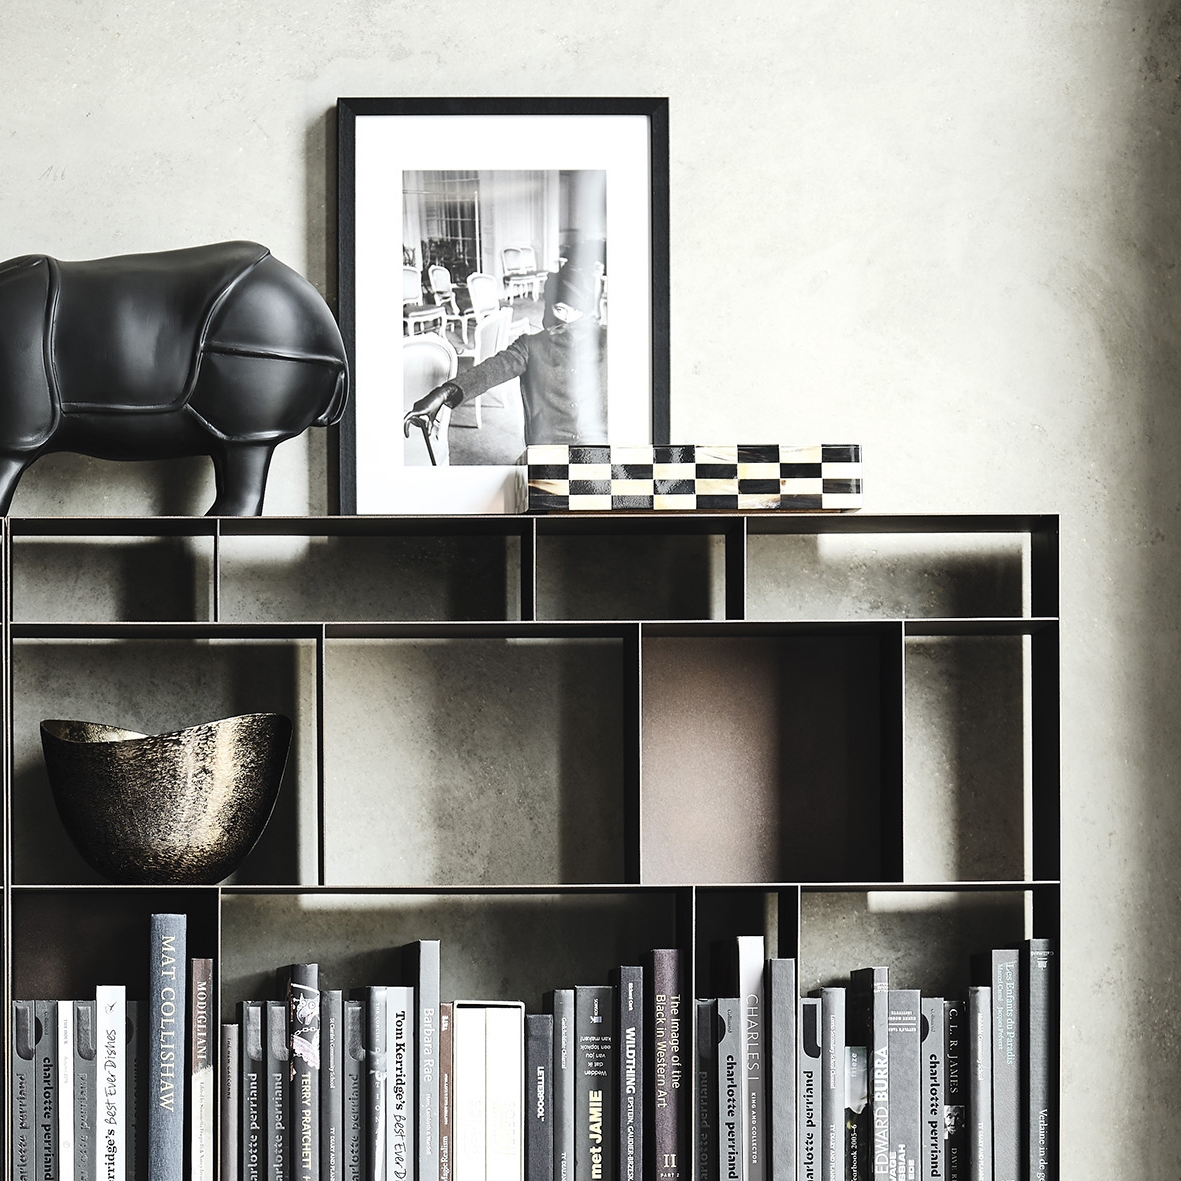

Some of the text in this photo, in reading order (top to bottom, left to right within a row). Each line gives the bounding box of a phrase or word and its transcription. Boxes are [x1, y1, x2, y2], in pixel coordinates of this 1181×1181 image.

[159, 935, 176, 1112] MAT COLLISHAW
[197, 981, 208, 1060] MODIGLIANI
[396, 1010, 406, 1040] Tom
[669, 994, 682, 1089] The Image of the
[746, 994, 760, 1071] CHARLES
[1006, 963, 1016, 1065] Les Enfants du Paradis
[104, 1029, 117, 1071] Dishes
[423, 1008, 435, 1082] Barbara Rae
[655, 994, 668, 1108] Black in Western Art
[947, 1008, 959, 1094] C. L. R. JAMES
[247, 1073, 260, 1130] perriand
[273, 1073, 285, 1130] perriand
[301, 1072, 312, 1106] TERRY
[348, 1074, 361, 1130] perriand
[393, 1043, 406, 1111] Kerridge's
[699, 1071, 710, 1128] perriand
[803, 1071, 816, 1127] perriand
[41, 1056, 55, 1181] charlotte perriand
[301, 1109, 312, 1170] PRATCHETT
[588, 1090, 603, 1144] JAMIE
[725, 1054, 739, 1179] charlotte perriand
[874, 1046, 889, 1174] EDWARD BURRA
[928, 1054, 941, 1178] charlotte perriand
[1039, 1108, 1048, 1144] Verlaine
[589, 1146, 602, 1180] met
[664, 1154, 677, 1168] II
[1039, 1147, 1048, 1156] in
[1039, 1159, 1048, 1170] de
